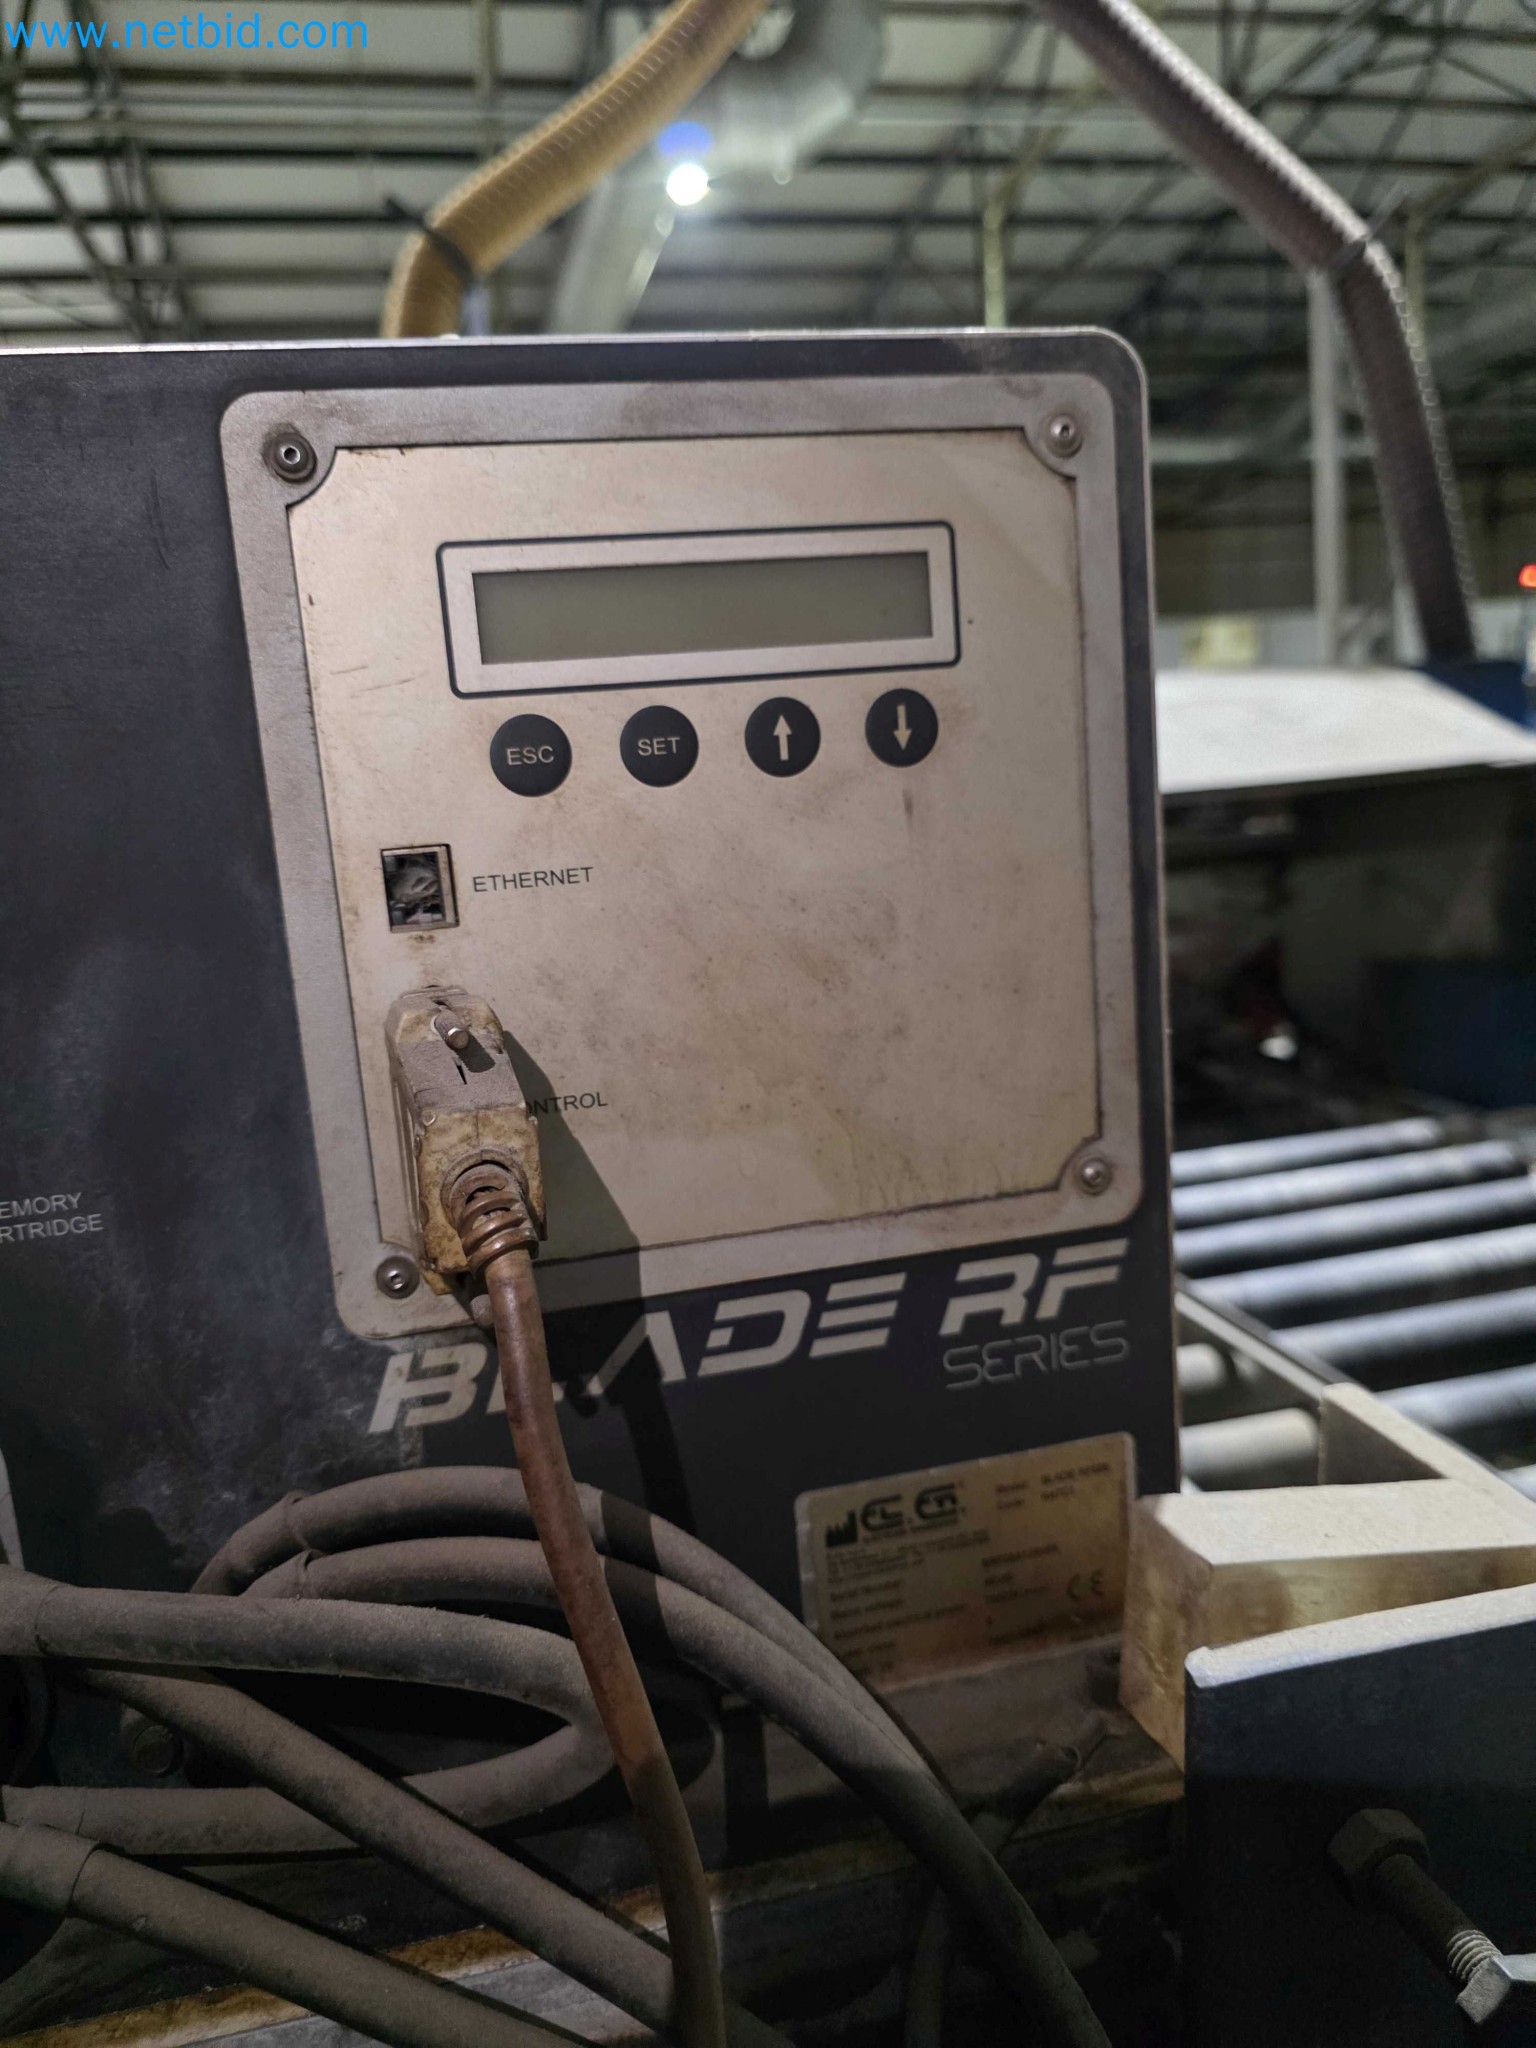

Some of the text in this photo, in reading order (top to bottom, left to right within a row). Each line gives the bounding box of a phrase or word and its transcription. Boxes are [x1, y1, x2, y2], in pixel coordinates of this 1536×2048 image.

[506, 745, 555, 766] ESC
[637, 736, 681, 756] SET
[472, 866, 594, 893] ETHERNET
[525, 1092, 608, 1116] NTROL
[0, 1192, 82, 1219] EMORY
[0, 1213, 104, 1243] RTRIDGE
[938, 1237, 1130, 1338] RF
[942, 1319, 1131, 1391] SERIES
